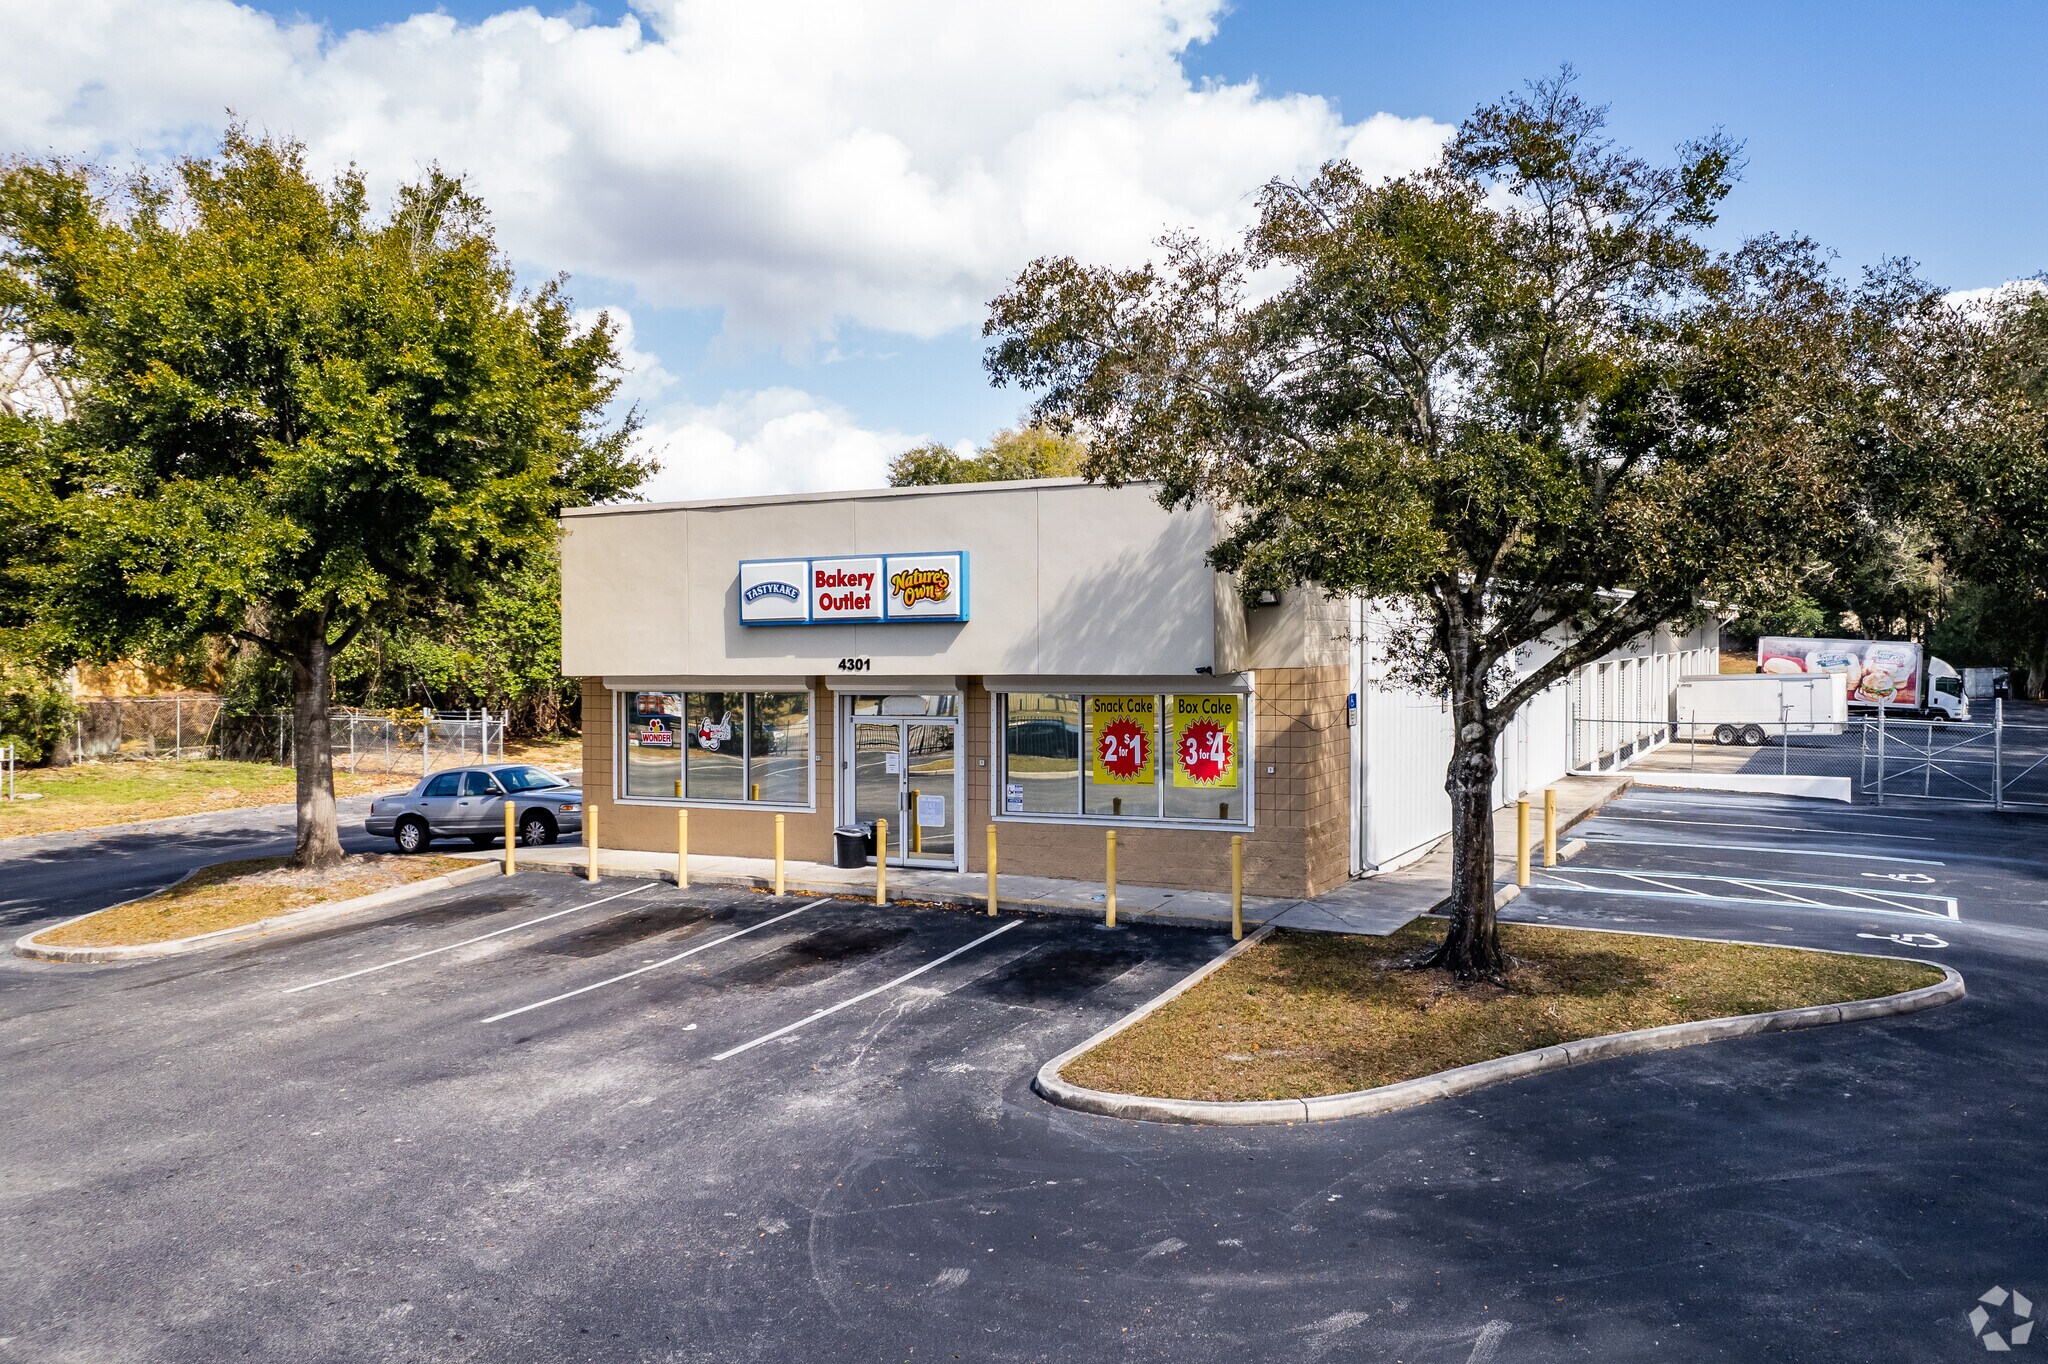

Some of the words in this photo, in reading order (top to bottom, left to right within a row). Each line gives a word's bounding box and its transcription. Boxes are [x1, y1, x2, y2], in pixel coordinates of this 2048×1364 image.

[815, 568, 875, 591] Bakery
[891, 568, 949, 596] Nature's
[746, 584, 798, 600] TASTYKAKE
[819, 590, 871, 611] Outlet
[903, 584, 935, 607] Own
[838, 658, 871, 671] 4301
[1094, 698, 1124, 713] Snack
[1127, 698, 1153, 713] Cake
[1178, 698, 1199, 714] Box
[1202, 698, 1232, 714] Cake
[642, 734, 671, 742] WONDER
[1105, 735, 1117, 761] 2
[1119, 746, 1128, 757] for
[1185, 738, 1198, 765] 3
[1199, 748, 1210, 760] for
